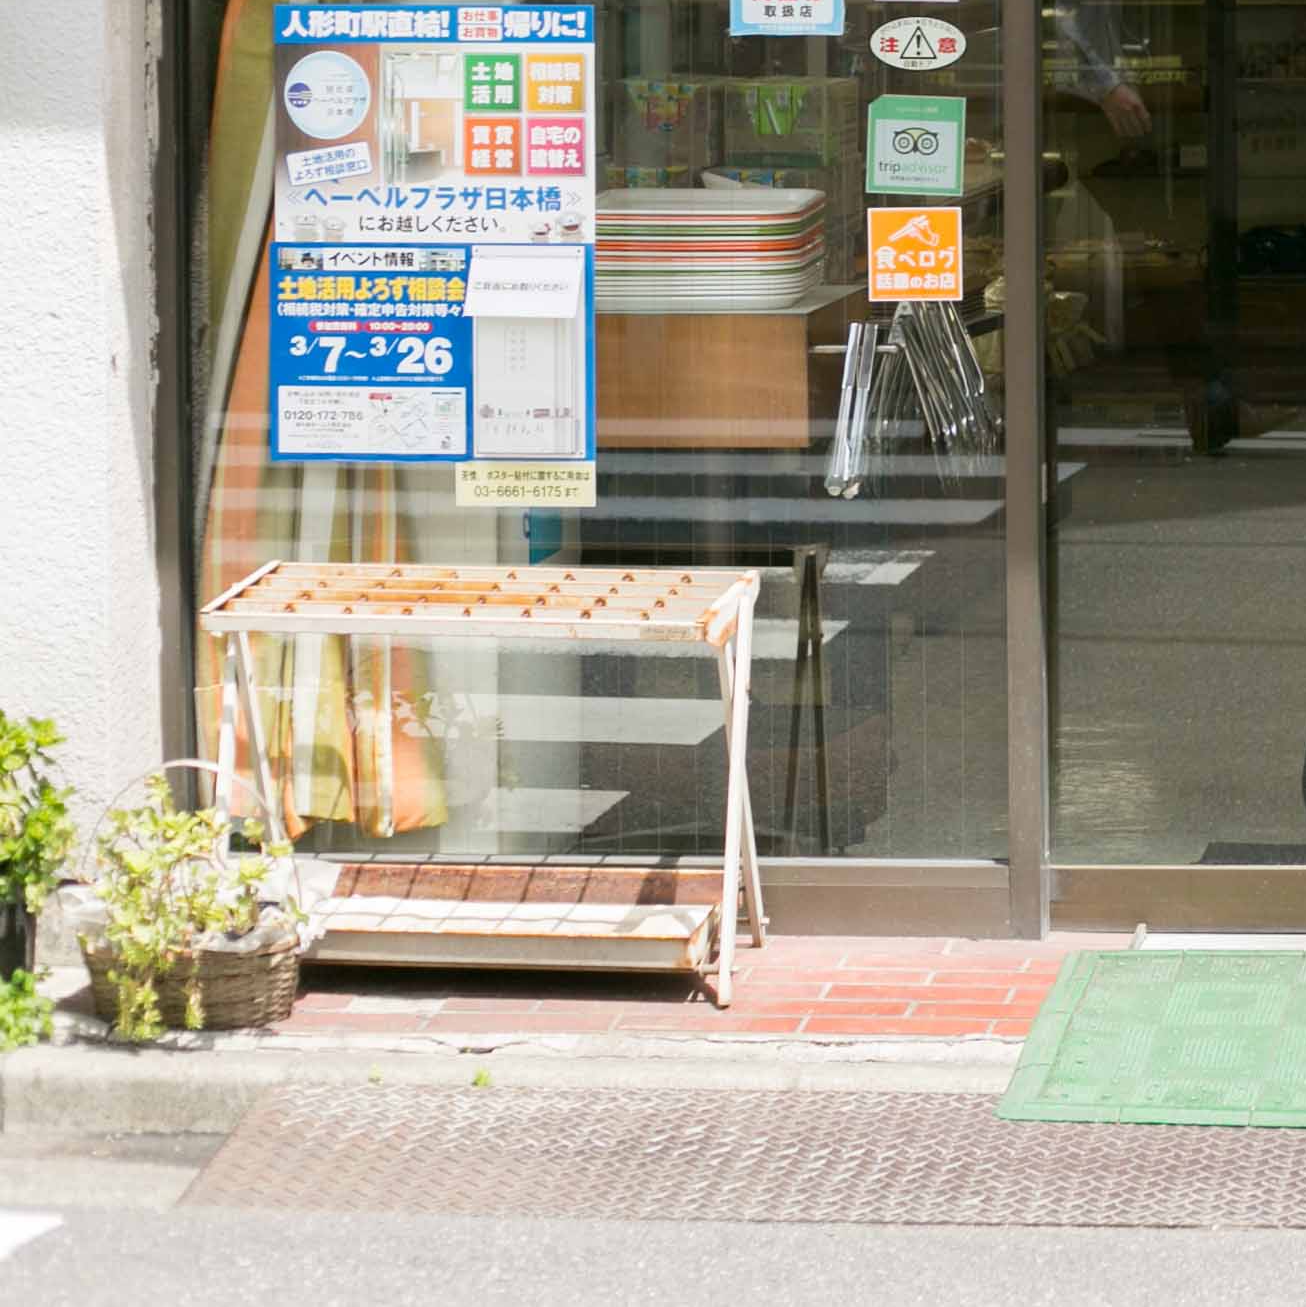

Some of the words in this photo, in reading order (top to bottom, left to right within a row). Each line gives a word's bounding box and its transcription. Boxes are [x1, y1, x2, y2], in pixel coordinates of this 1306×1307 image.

[763, 4, 814, 18] 取扱店
[504, 10, 588, 40] 帰りに!
[530, 124, 581, 146] 自宅の
[327, 251, 416, 268] イベント情報
[874, 245, 957, 270] 食べログ
[277, 276, 466, 302] 土地活用よろず相談会
